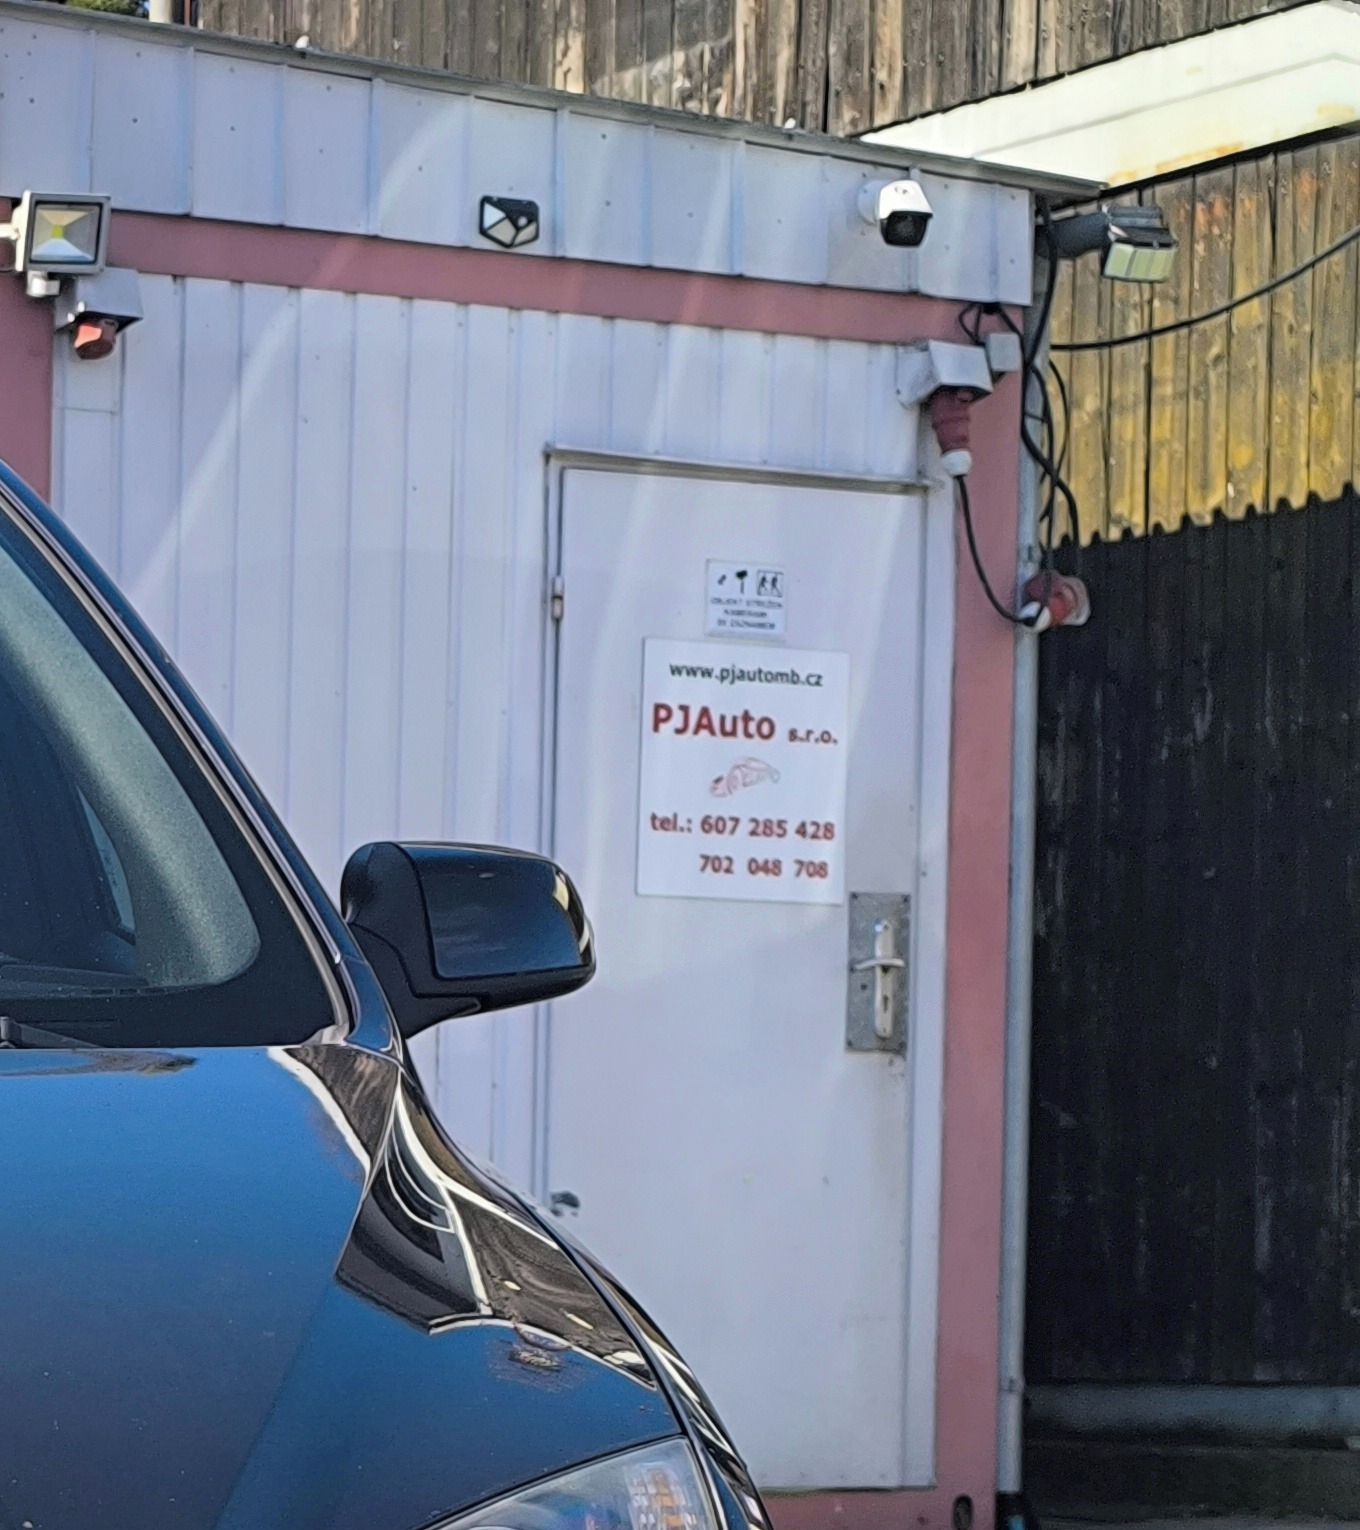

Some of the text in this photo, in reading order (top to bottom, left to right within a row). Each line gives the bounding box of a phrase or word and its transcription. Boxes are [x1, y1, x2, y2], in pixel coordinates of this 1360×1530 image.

[669, 664, 823, 687] www.pjautomb.cz
[652, 703, 838, 746] PJAuto s.r.o.
[650, 812, 836, 841] tel.: 607 285 428
[699, 854, 829, 879] 702 048 708
